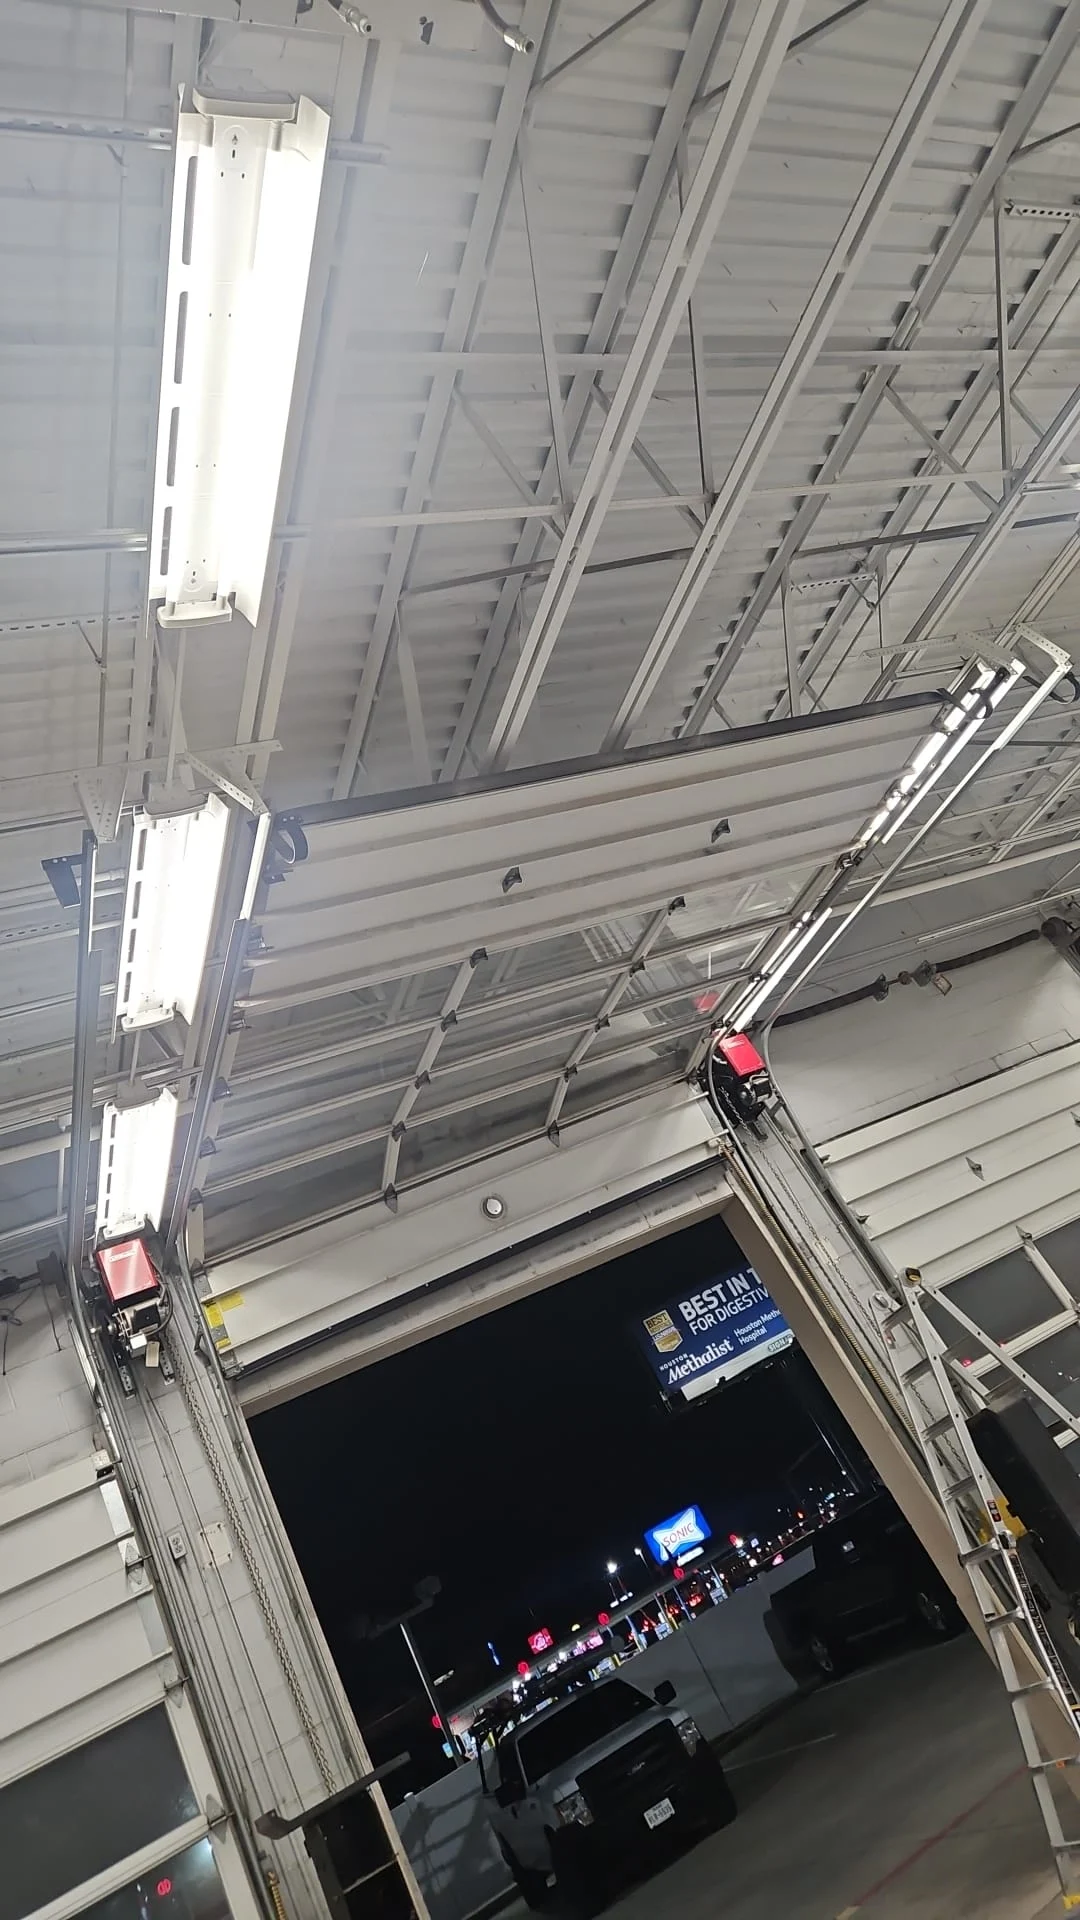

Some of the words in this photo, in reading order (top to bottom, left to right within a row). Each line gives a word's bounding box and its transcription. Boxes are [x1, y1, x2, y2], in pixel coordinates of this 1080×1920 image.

[678, 1283, 727, 1322] BEST
[726, 1273, 751, 1297] IN
[689, 1313, 717, 1336] FOR
[733, 1320, 763, 1337] Houston
[737, 1327, 768, 1346] Hospital
[659, 1353, 689, 1371] HOUSTON
[667, 1339, 735, 1385] Methodist
[663, 1522, 694, 1548] SONIC
